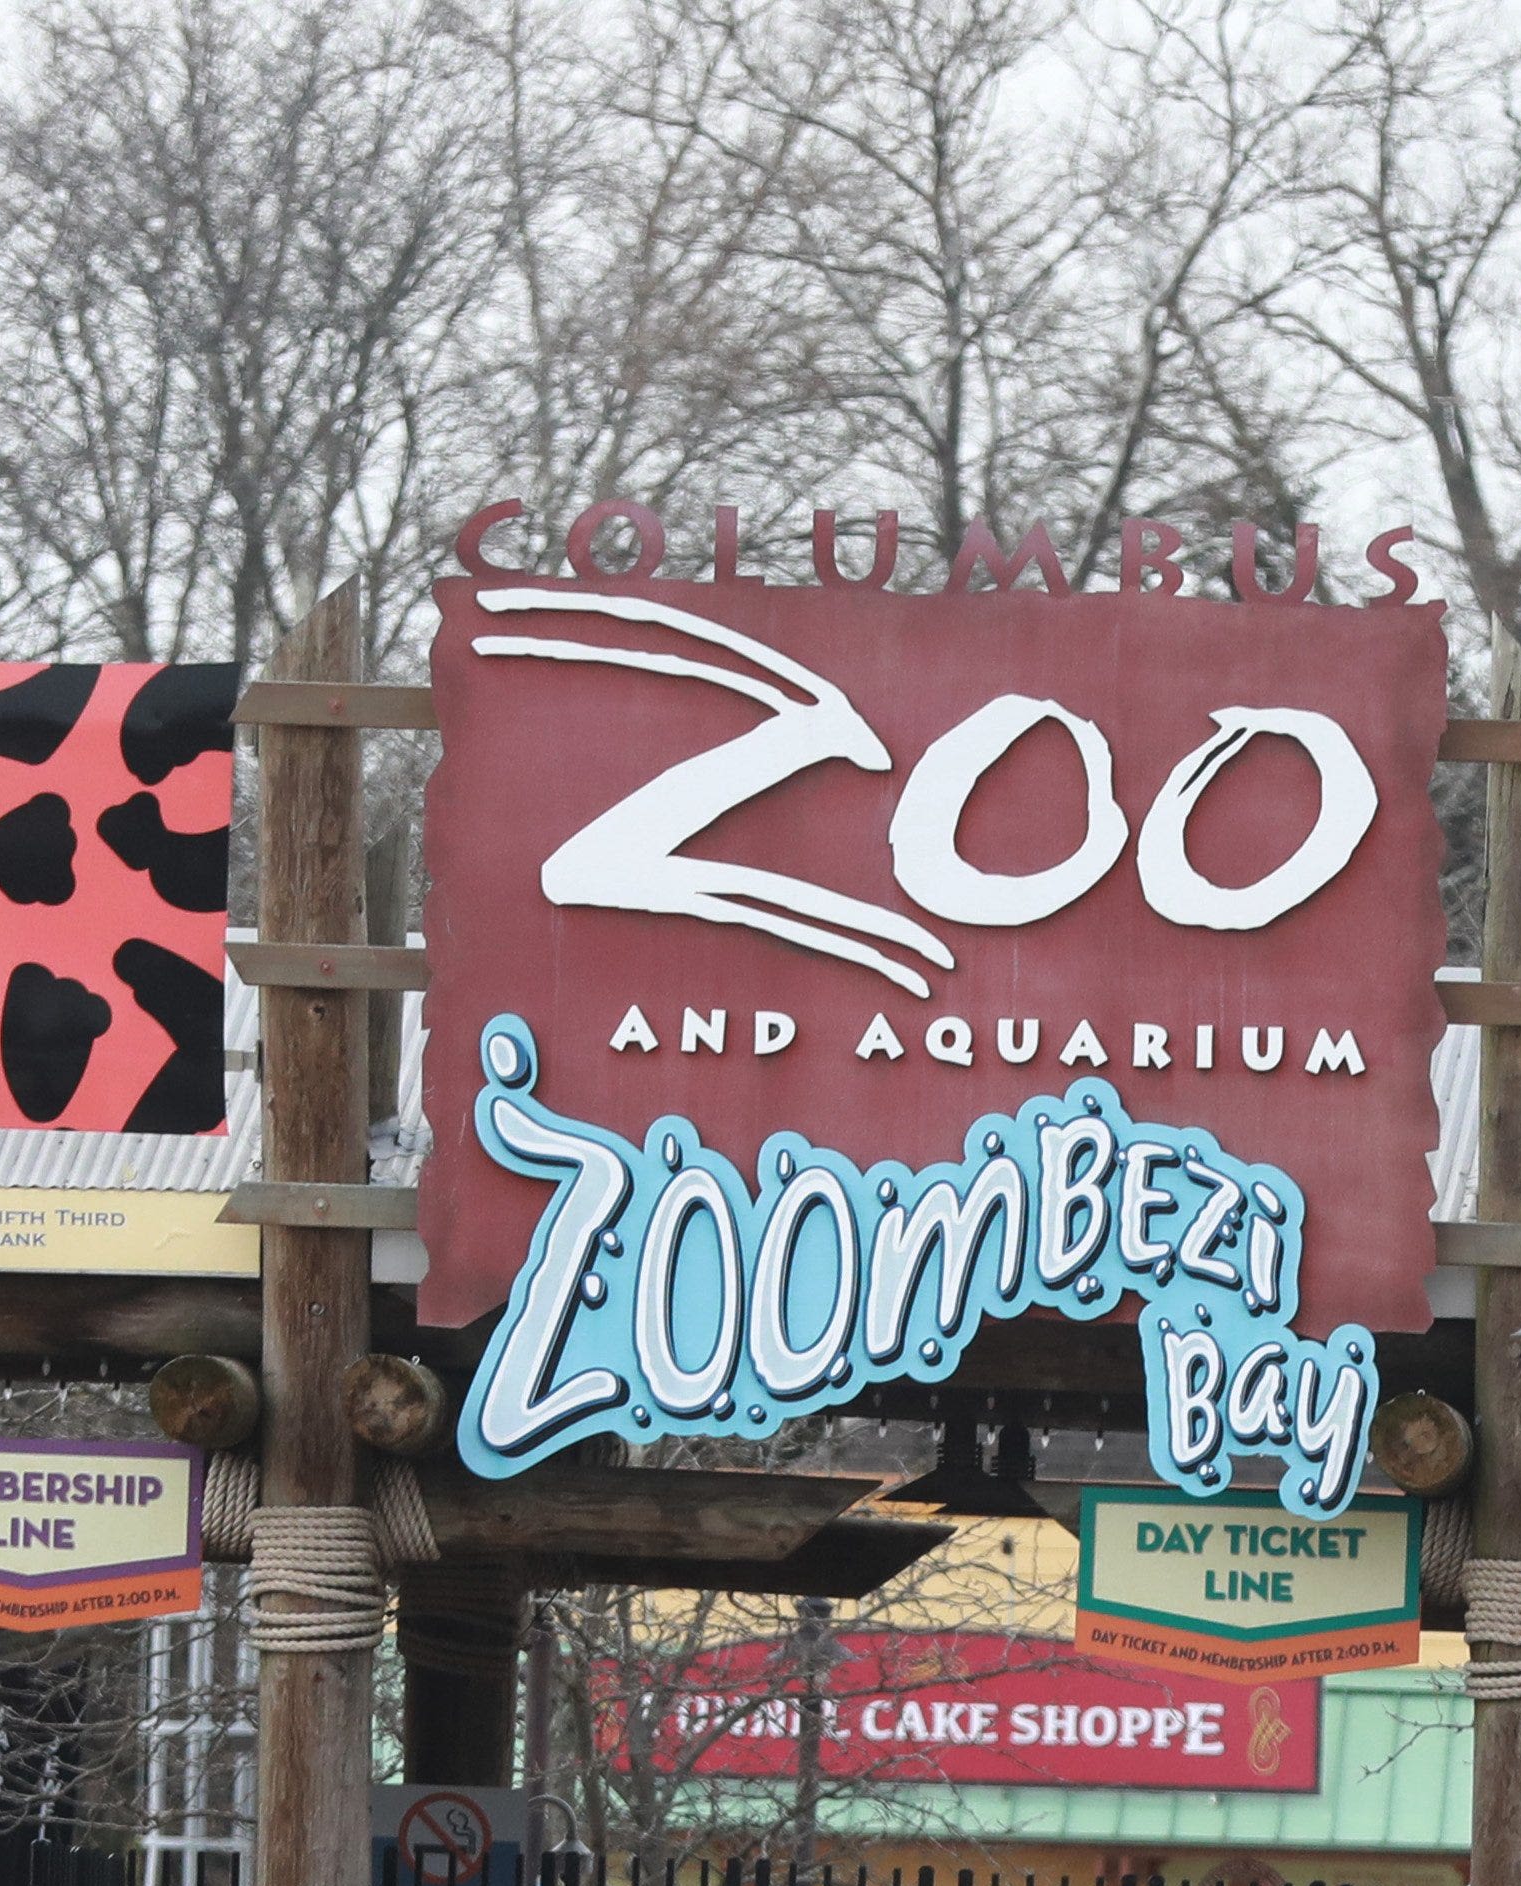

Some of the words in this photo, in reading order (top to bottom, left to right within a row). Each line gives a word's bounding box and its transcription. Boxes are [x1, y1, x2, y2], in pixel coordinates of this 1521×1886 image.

[456, 497, 1420, 601] COLUMBUS
[472, 587, 1379, 997] ZOO
[609, 1004, 797, 1057] AND
[854, 1012, 1367, 1077] AQUARIUM
[1136, 1521, 1214, 1554] DAY
[1224, 1524, 1368, 1560] TICKET
[72, 1593, 115, 1614] AFTER
[117, 1590, 151, 1608] 2:00
[153, 1587, 181, 1602] P.M.
[1204, 1569, 1295, 1603] LINE
[1091, 1627, 1118, 1645] DAY
[1121, 1632, 1167, 1655] TICKET
[1169, 1645, 1198, 1662] AND
[1200, 1650, 1288, 1673] MEMBERSHIP
[1290, 1648, 1333, 1666] AFTER
[1336, 1643, 1370, 1659] 2:00
[1373, 1640, 1400, 1656] P.M.
[861, 1699, 998, 1744] CAKE
[1008, 1701, 1226, 1757] SHOPPE
